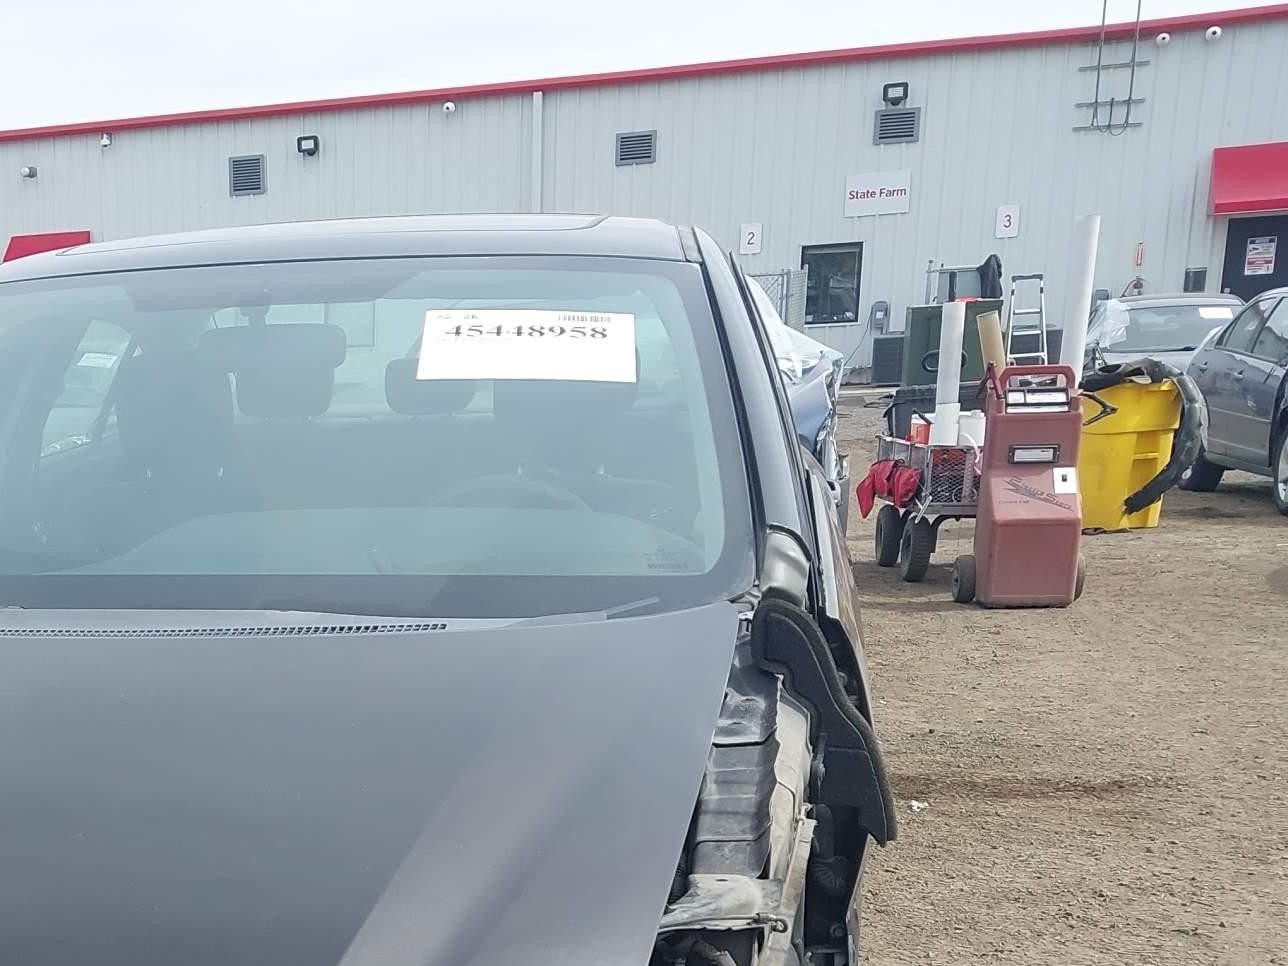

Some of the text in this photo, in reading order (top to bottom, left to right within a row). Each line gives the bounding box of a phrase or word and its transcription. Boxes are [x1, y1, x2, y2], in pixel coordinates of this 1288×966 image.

[848, 187, 907, 200] State Farm
[1003, 214, 1012, 228] 3
[747, 231, 755, 245] 2
[444, 324, 609, 340] 45448958
